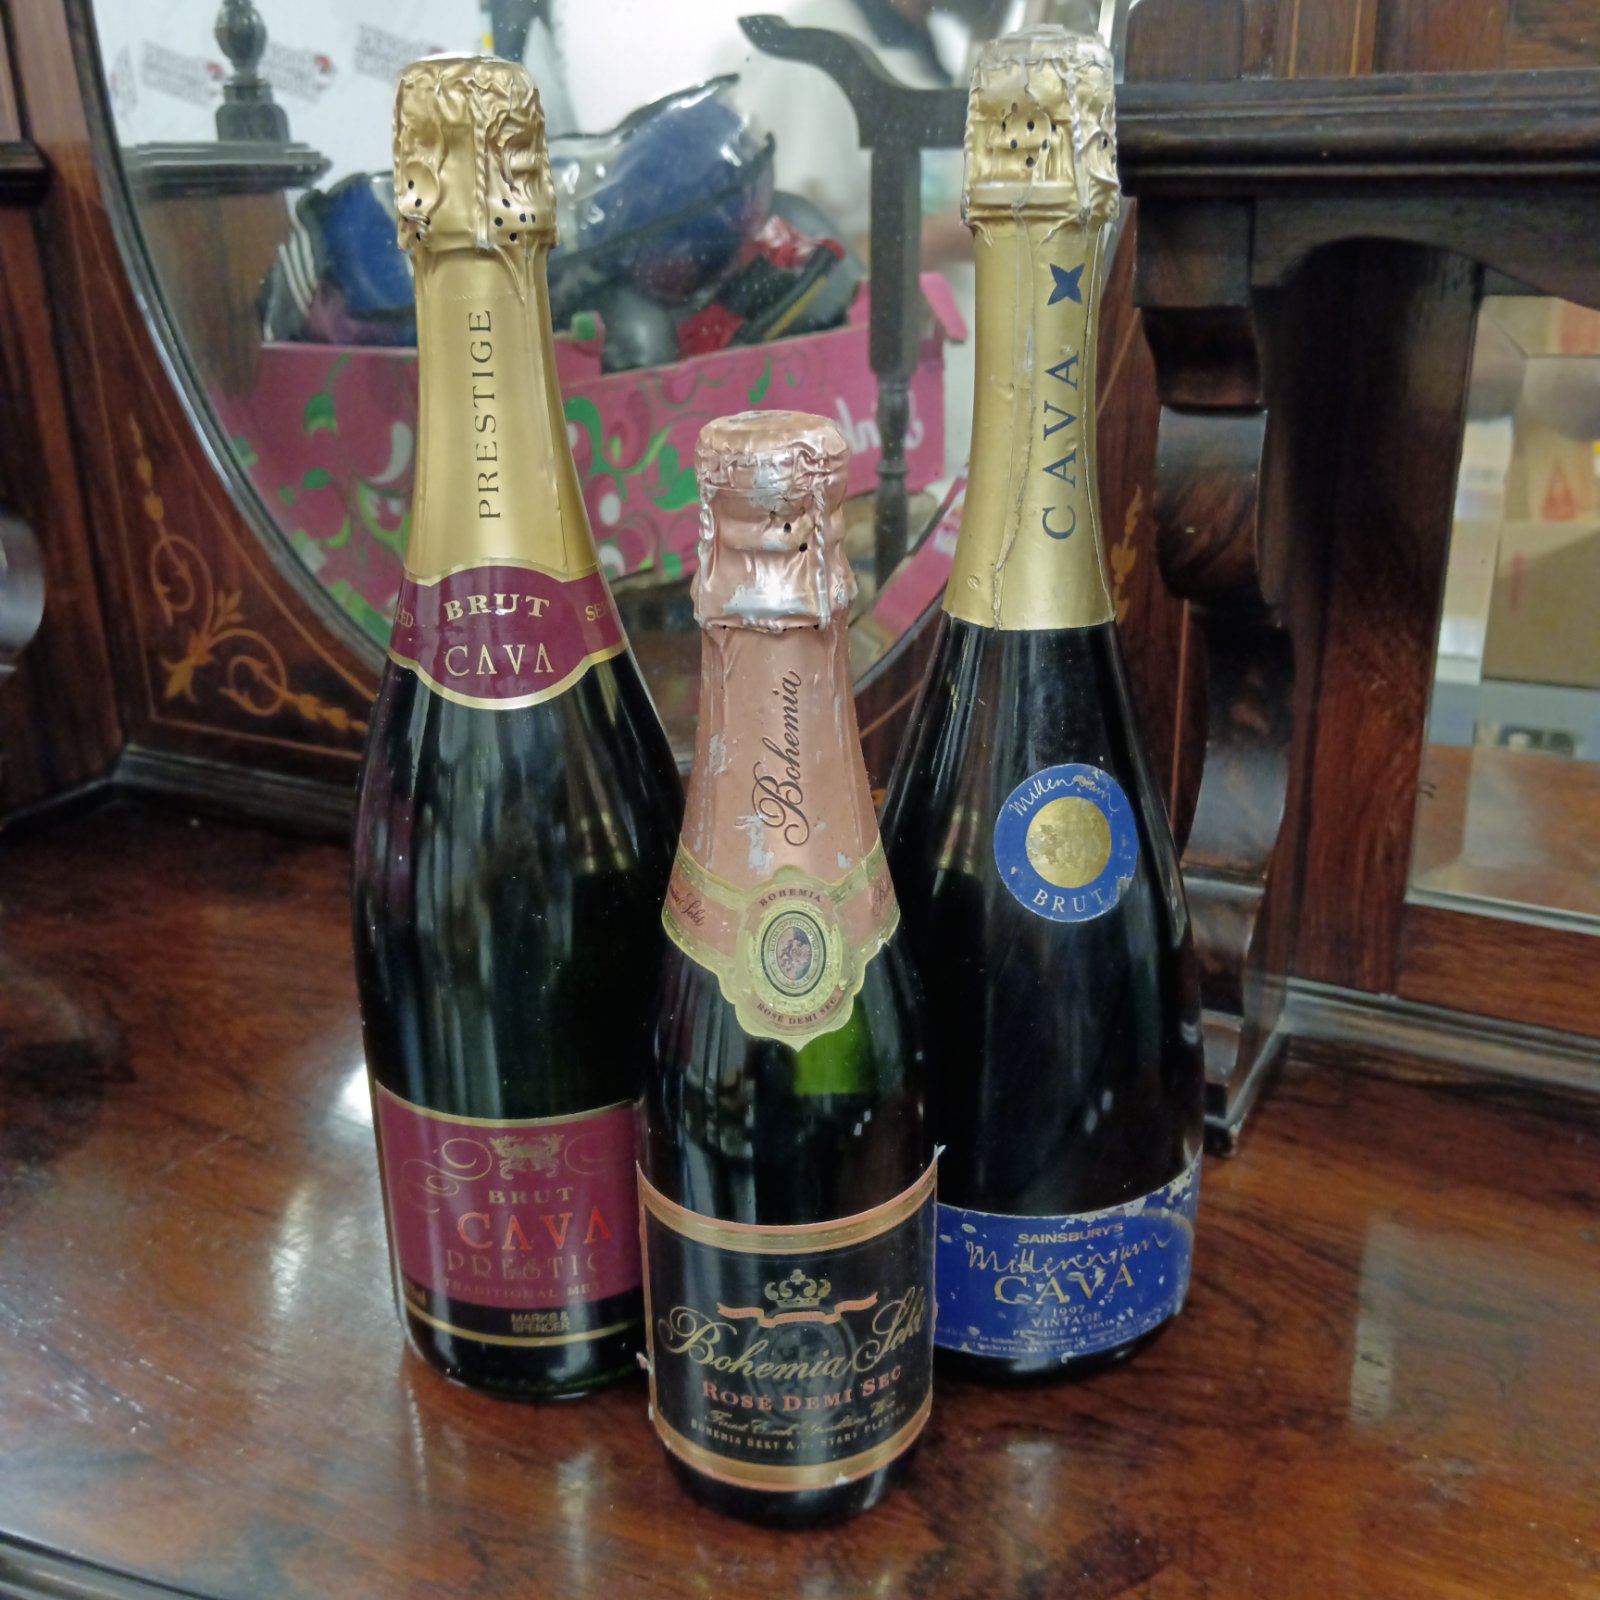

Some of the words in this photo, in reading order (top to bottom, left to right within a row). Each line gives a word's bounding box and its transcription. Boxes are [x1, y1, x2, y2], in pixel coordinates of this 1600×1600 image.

[468, 310, 501, 519] PRESTIGE
[1042, 351, 1080, 541] CAVA
[443, 593, 550, 622] BRUT
[445, 643, 554, 677] CAVA
[752, 670, 810, 847] Bohemia
[758, 888, 822, 908] BOHEMIA
[1032, 887, 1104, 913] BRUT
[788, 1012, 818, 1026] DEMI
[819, 998, 837, 1015] SEC
[488, 1186, 574, 1205] BRUT
[457, 1205, 611, 1252] CAVA
[1017, 1222, 1124, 1244] SAINSBURY'S
[994, 1262, 1136, 1305] CAVA
[511, 1312, 557, 1323] MARKS
[1031, 1310, 1103, 1328] VINTAGE
[1052, 1305, 1085, 1318] 1997
[657, 1305, 852, 1380] Bohemia
[783, 1388, 852, 1412] DEMI
[862, 1365, 902, 1398] SEC
